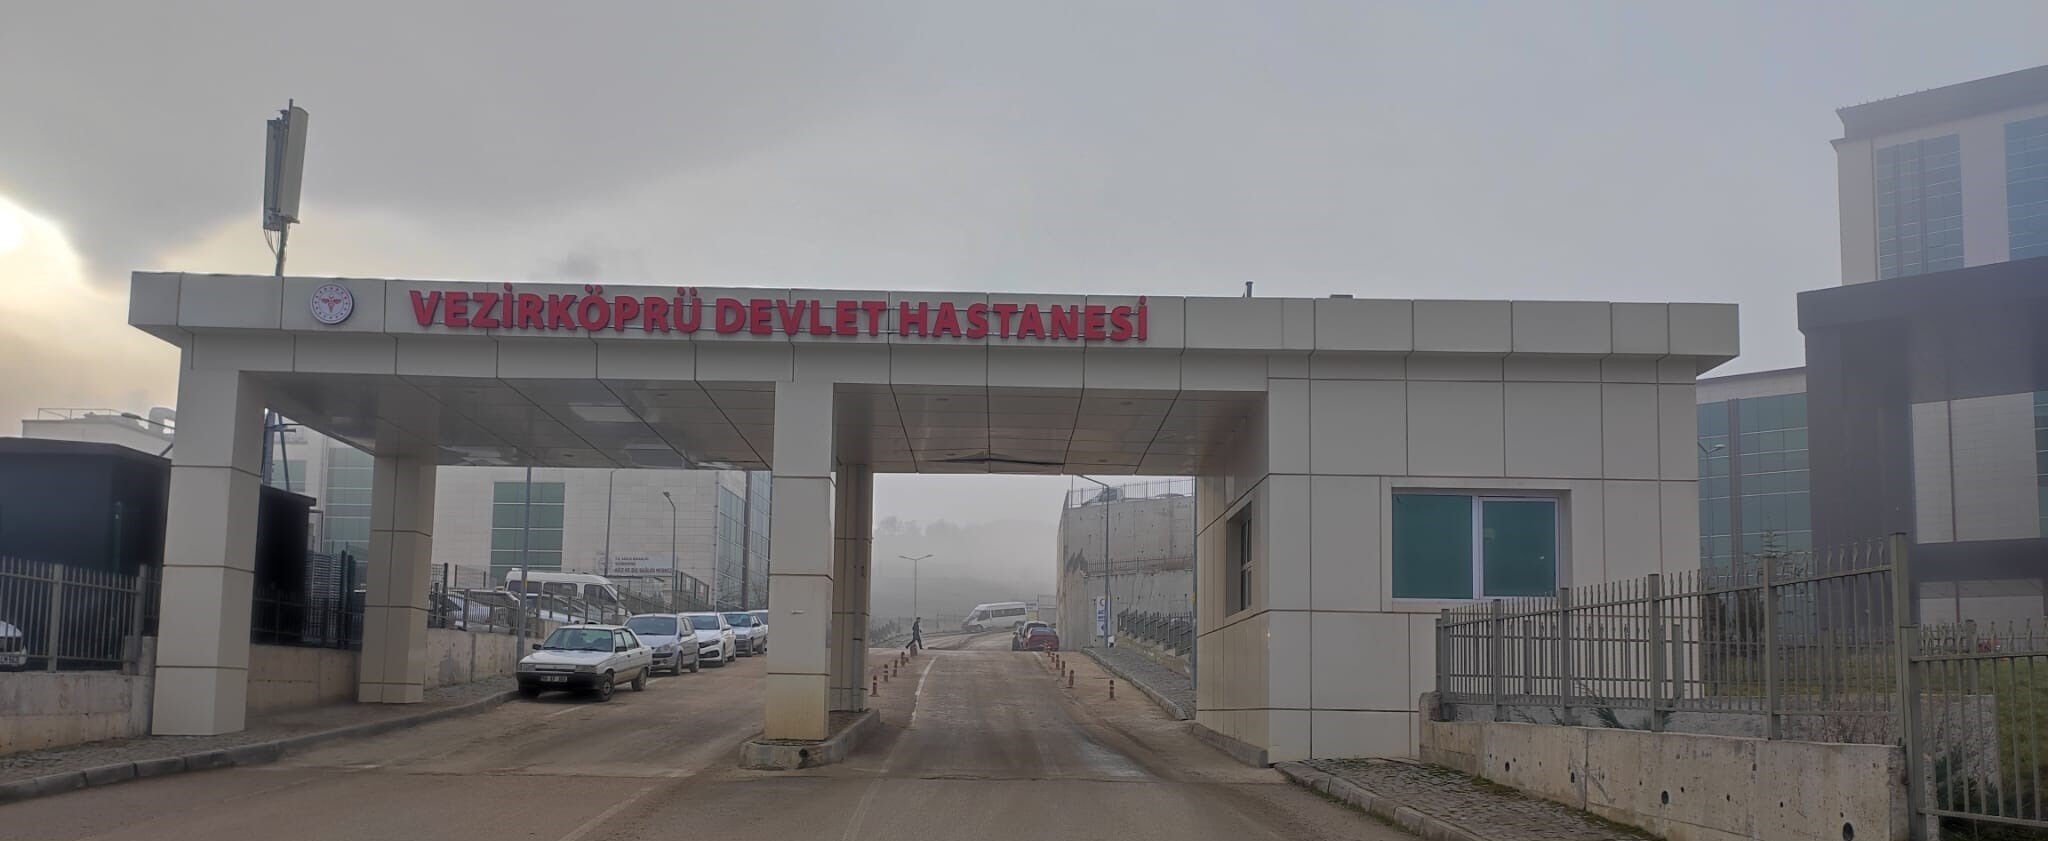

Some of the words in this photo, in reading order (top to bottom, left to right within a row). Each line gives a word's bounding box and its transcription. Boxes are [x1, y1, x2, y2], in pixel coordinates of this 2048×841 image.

[409, 282, 702, 334] VEZİRKÖPRÜ
[715, 297, 887, 337] DEVLET
[900, 295, 1148, 342] HASTANESİ
